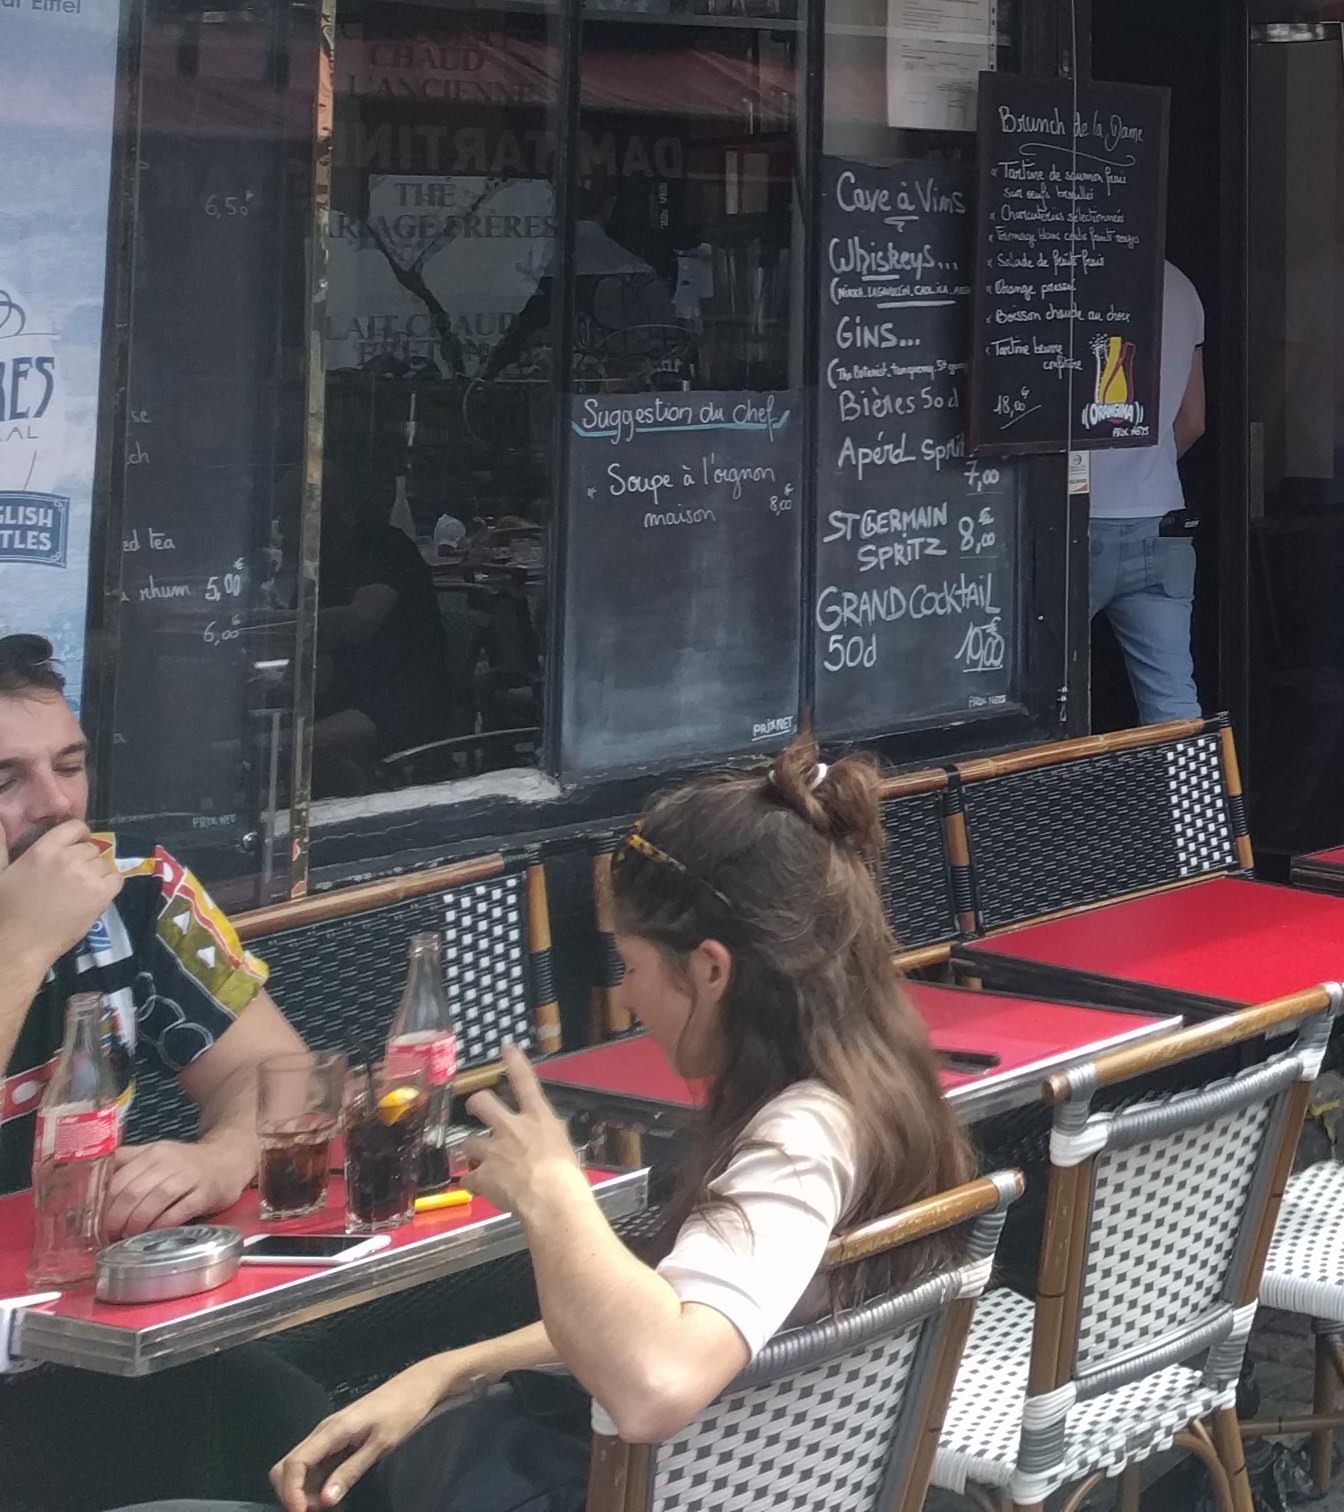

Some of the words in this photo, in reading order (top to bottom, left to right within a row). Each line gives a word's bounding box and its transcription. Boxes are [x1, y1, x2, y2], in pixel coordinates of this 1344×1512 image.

[998, 105, 1066, 136] Brunch
[836, 171, 892, 212] Cave
[897, 181, 915, 211] à
[583, 398, 692, 445] Suggestion
[700, 402, 724, 423] du
[839, 387, 915, 422] Bières
[7, 426, 38, 441] AL
[921, 434, 966, 472] Sprit
[608, 463, 673, 505] Soupe
[682, 465, 694, 486] à
[702, 453, 775, 500] l'oignon
[644, 504, 716, 528] maison
[860, 501, 949, 539] GERMAIN
[149, 527, 176, 550] tea
[816, 586, 906, 632] GRAND
